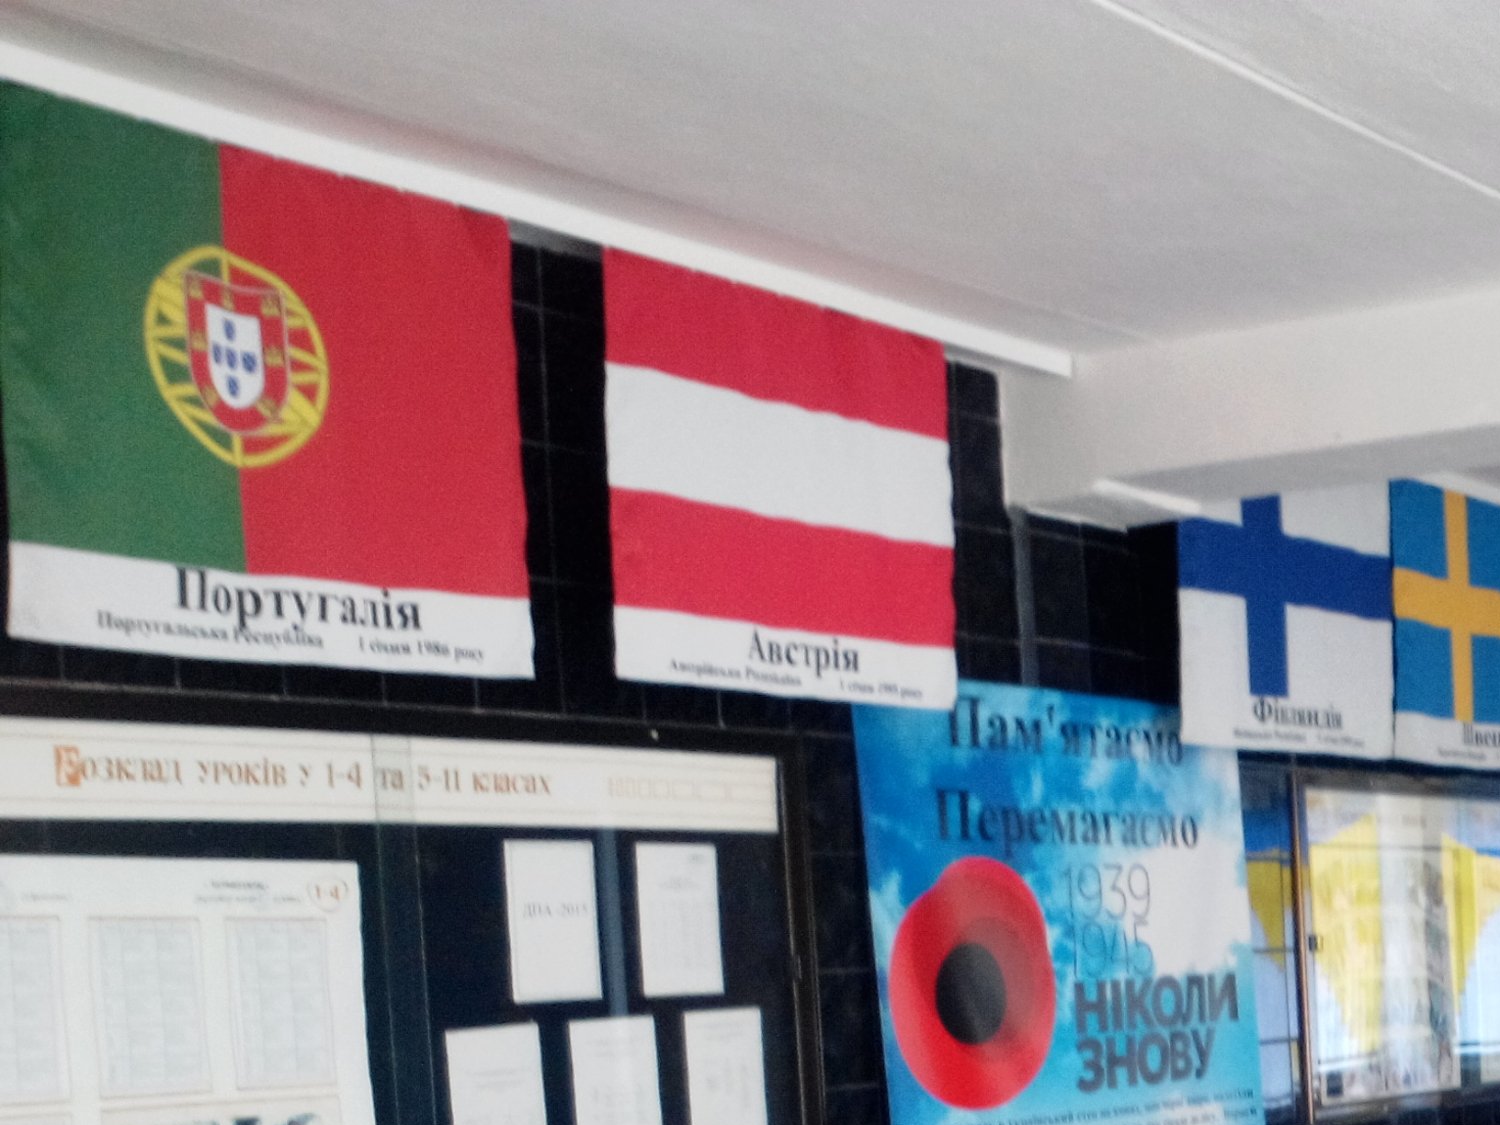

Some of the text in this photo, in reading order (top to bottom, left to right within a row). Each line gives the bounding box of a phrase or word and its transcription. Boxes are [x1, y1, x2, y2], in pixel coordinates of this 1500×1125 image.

[175, 566, 422, 633] Португалія
[749, 627, 860, 678] Австрія
[947, 694, 1184, 767] Пам'ятаємо
[935, 788, 1199, 862] Перемагаємо
[1064, 862, 1151, 921] 1939
[1073, 971, 1240, 1034] НІКОЛИ
[1076, 1026, 1217, 1094] ЗНОВУ
